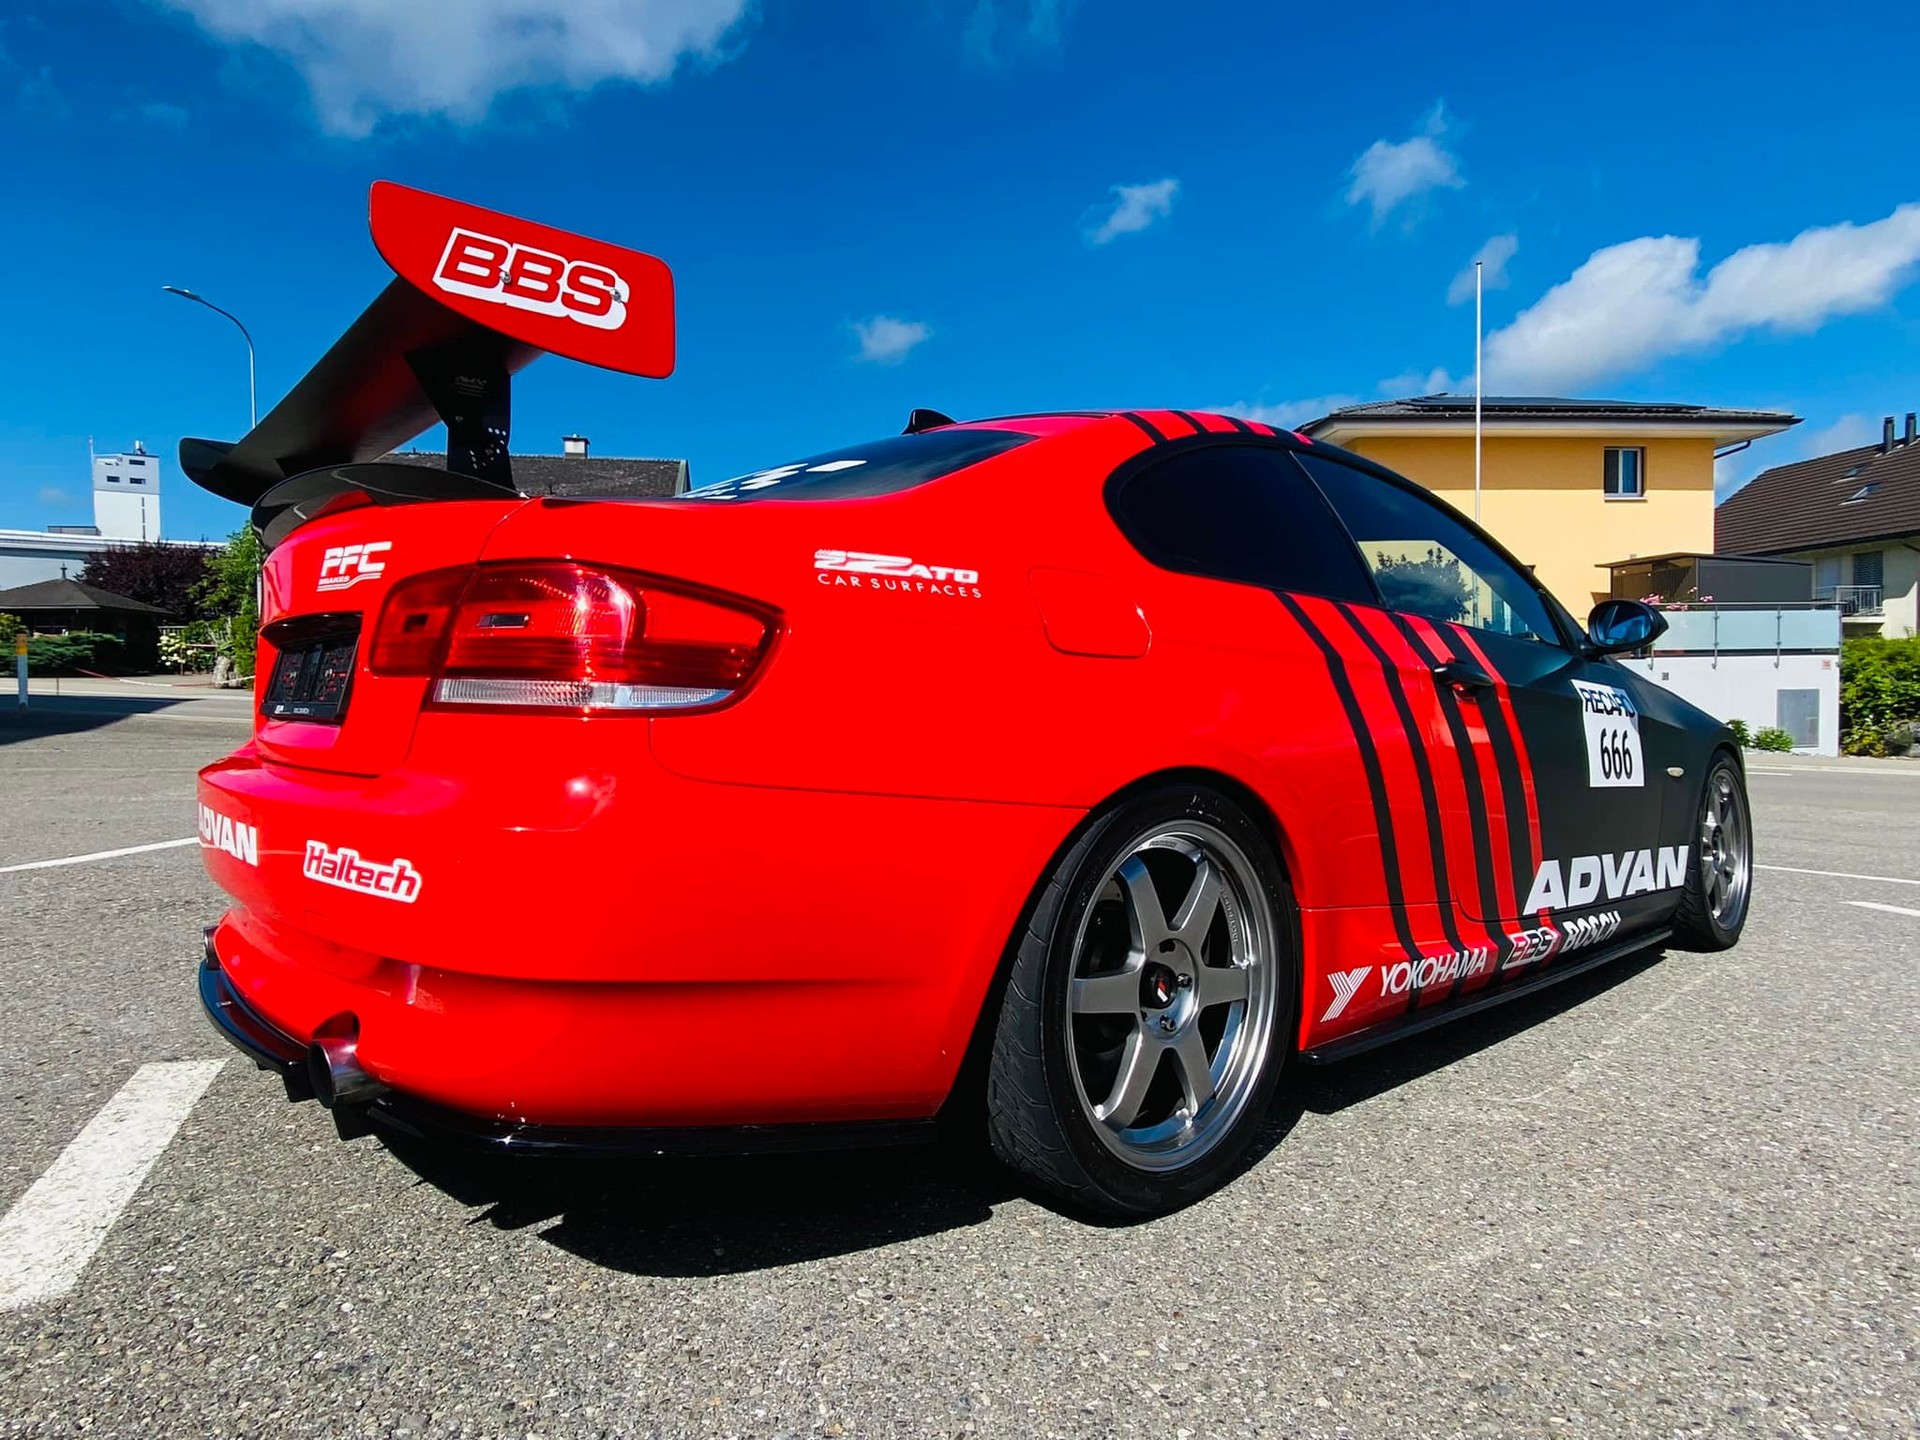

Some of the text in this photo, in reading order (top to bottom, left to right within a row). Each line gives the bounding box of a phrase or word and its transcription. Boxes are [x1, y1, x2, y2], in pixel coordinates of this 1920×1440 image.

[433, 227, 630, 330] BBS
[321, 541, 392, 577] PFC
[817, 573, 982, 598] CAR SURFACES
[1600, 728, 1633, 780] 666
[305, 843, 420, 900] Haltech
[1523, 846, 1689, 915] ADVAN
[1502, 926, 1558, 970] BBS
[1560, 910, 1622, 953] BOSCH
[1381, 947, 1487, 996] YOKOHAMA
